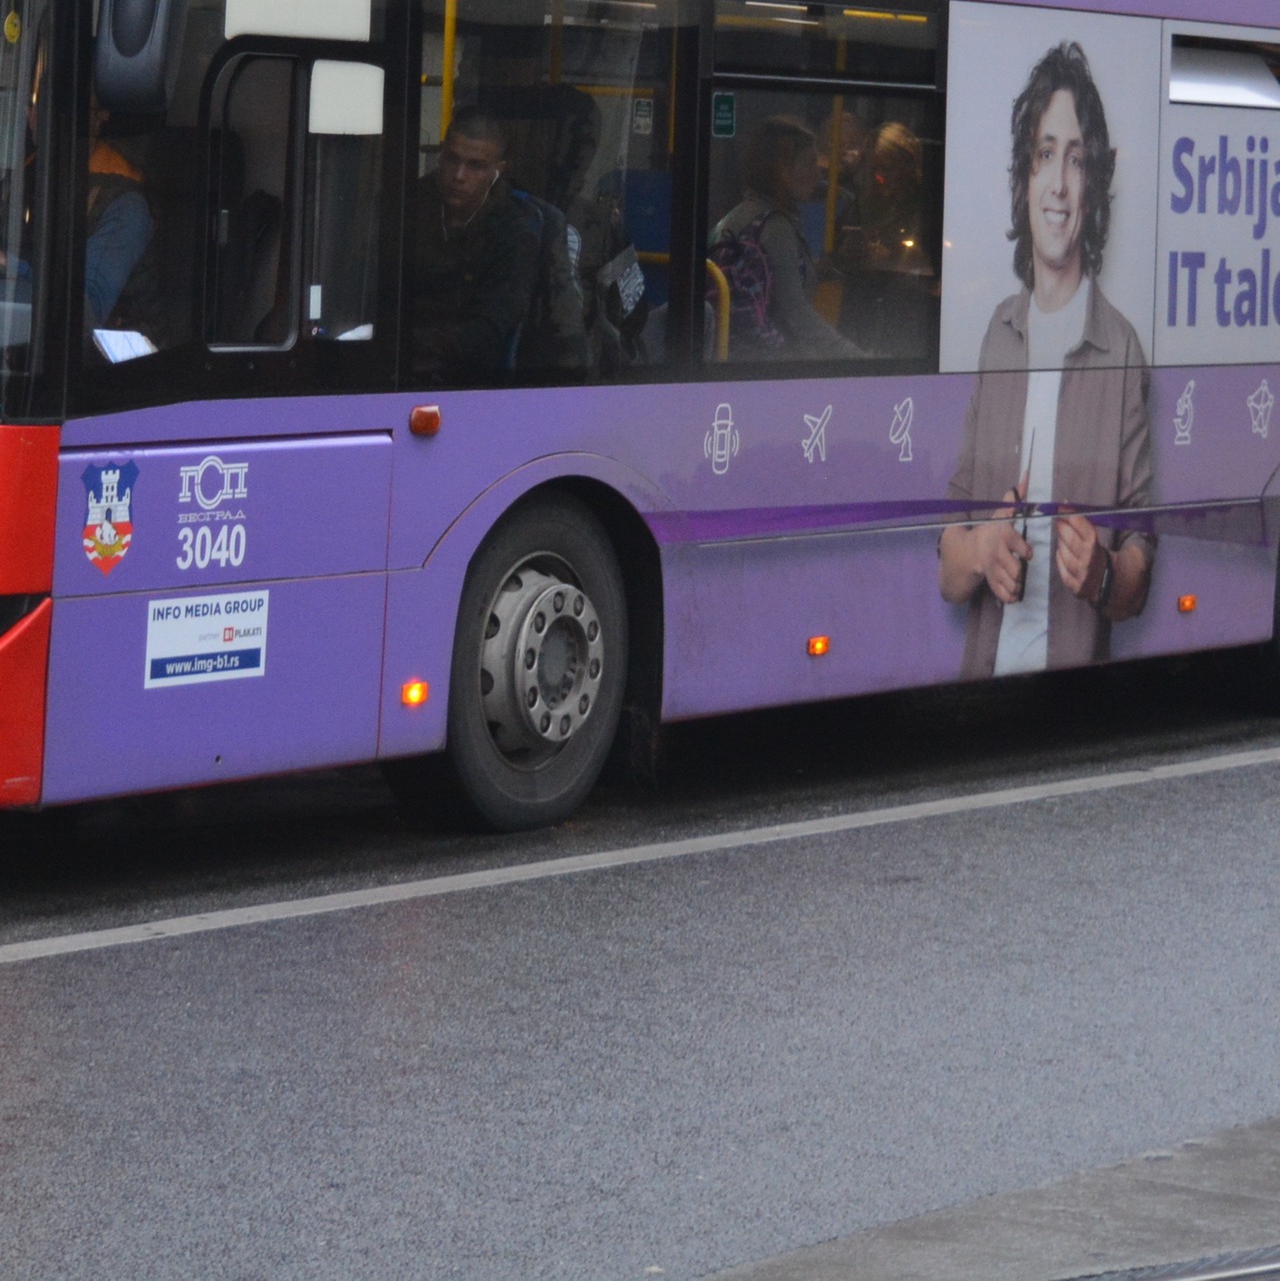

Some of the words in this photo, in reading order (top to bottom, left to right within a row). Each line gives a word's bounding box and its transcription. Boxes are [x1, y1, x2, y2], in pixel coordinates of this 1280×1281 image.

[1167, 251, 1206, 327] IT
[178, 455, 249, 510] ГСП
[177, 509, 246, 524] БЕОГРАД
[176, 524, 246, 570] 3040
[152, 606, 181, 621] INFO
[185, 602, 221, 619] MEDIA
[225, 598, 264, 615] GROUP
[234, 627, 262, 639] PLAKATI
[166, 654, 240, 674] www.img-b1.rs
